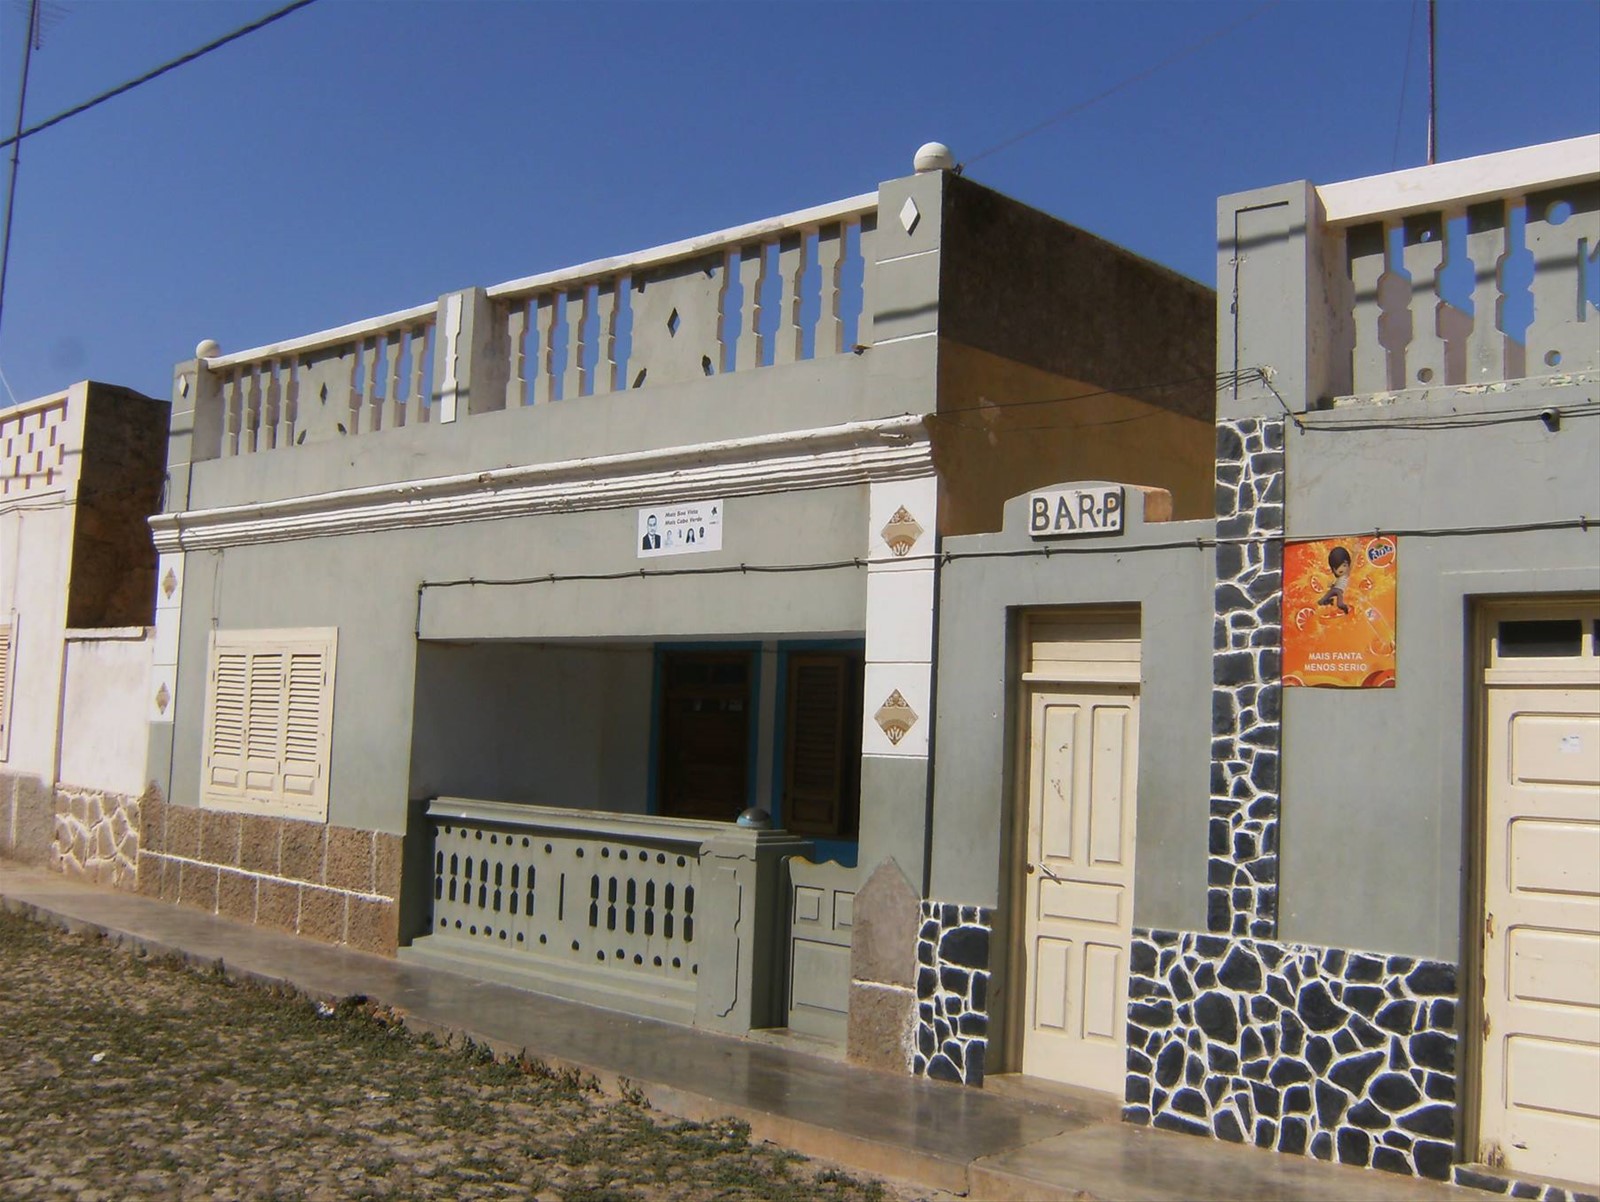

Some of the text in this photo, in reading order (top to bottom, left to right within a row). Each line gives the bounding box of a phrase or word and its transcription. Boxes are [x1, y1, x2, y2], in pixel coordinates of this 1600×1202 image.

[1308, 652, 1363, 660] MAIS FANTA
[1304, 663, 1336, 671] MENOS
